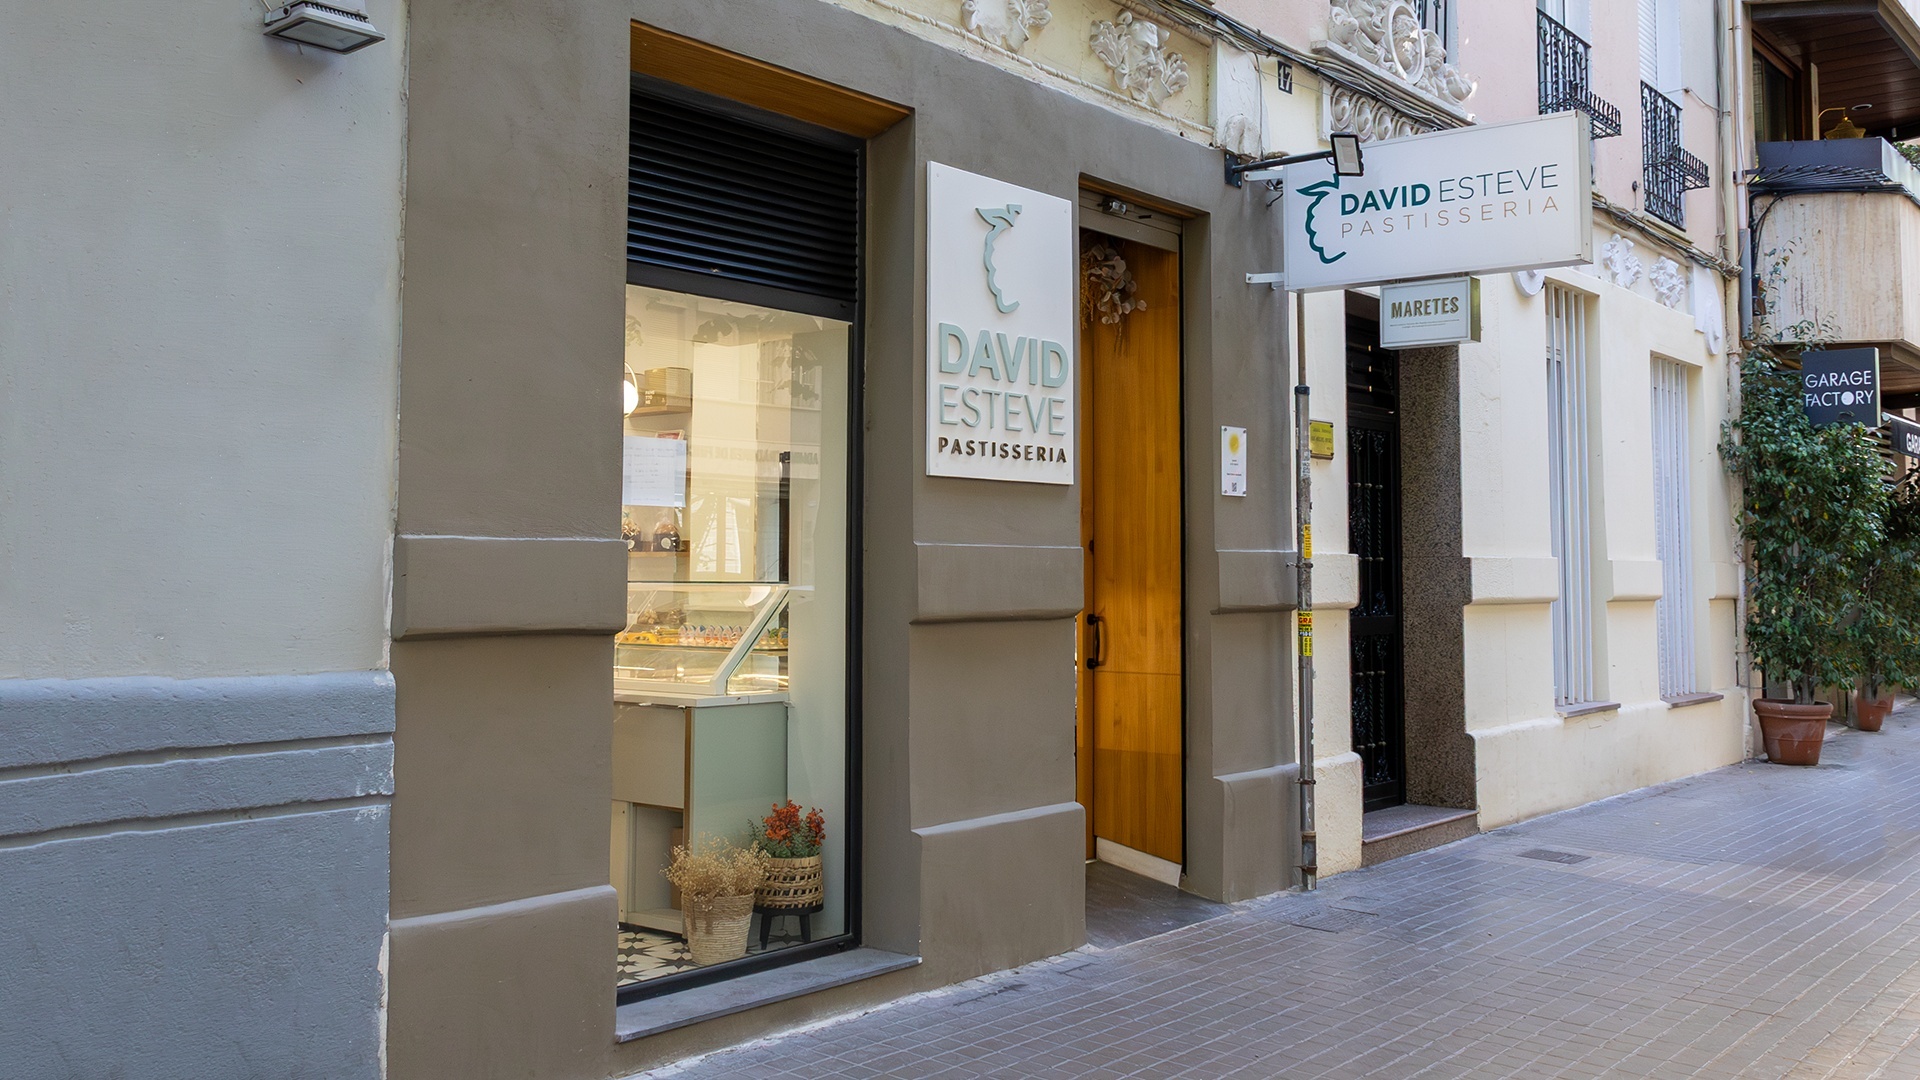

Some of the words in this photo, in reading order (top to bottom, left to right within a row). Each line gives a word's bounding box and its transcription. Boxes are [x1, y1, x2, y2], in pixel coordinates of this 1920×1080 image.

[1279, 65, 1292, 91] 17
[1340, 183, 1431, 216] DAVID
[1439, 163, 1559, 202] ESTEVE
[1341, 195, 1559, 239] PASTISSERIA
[1390, 296, 1460, 320] MARETES
[938, 322, 1069, 388] DAVID
[1805, 370, 1872, 388] GARAGE
[939, 383, 1067, 436] ESTEVE
[1804, 390, 1874, 408] FACTORY
[938, 437, 1067, 463] PASTISSERIA
